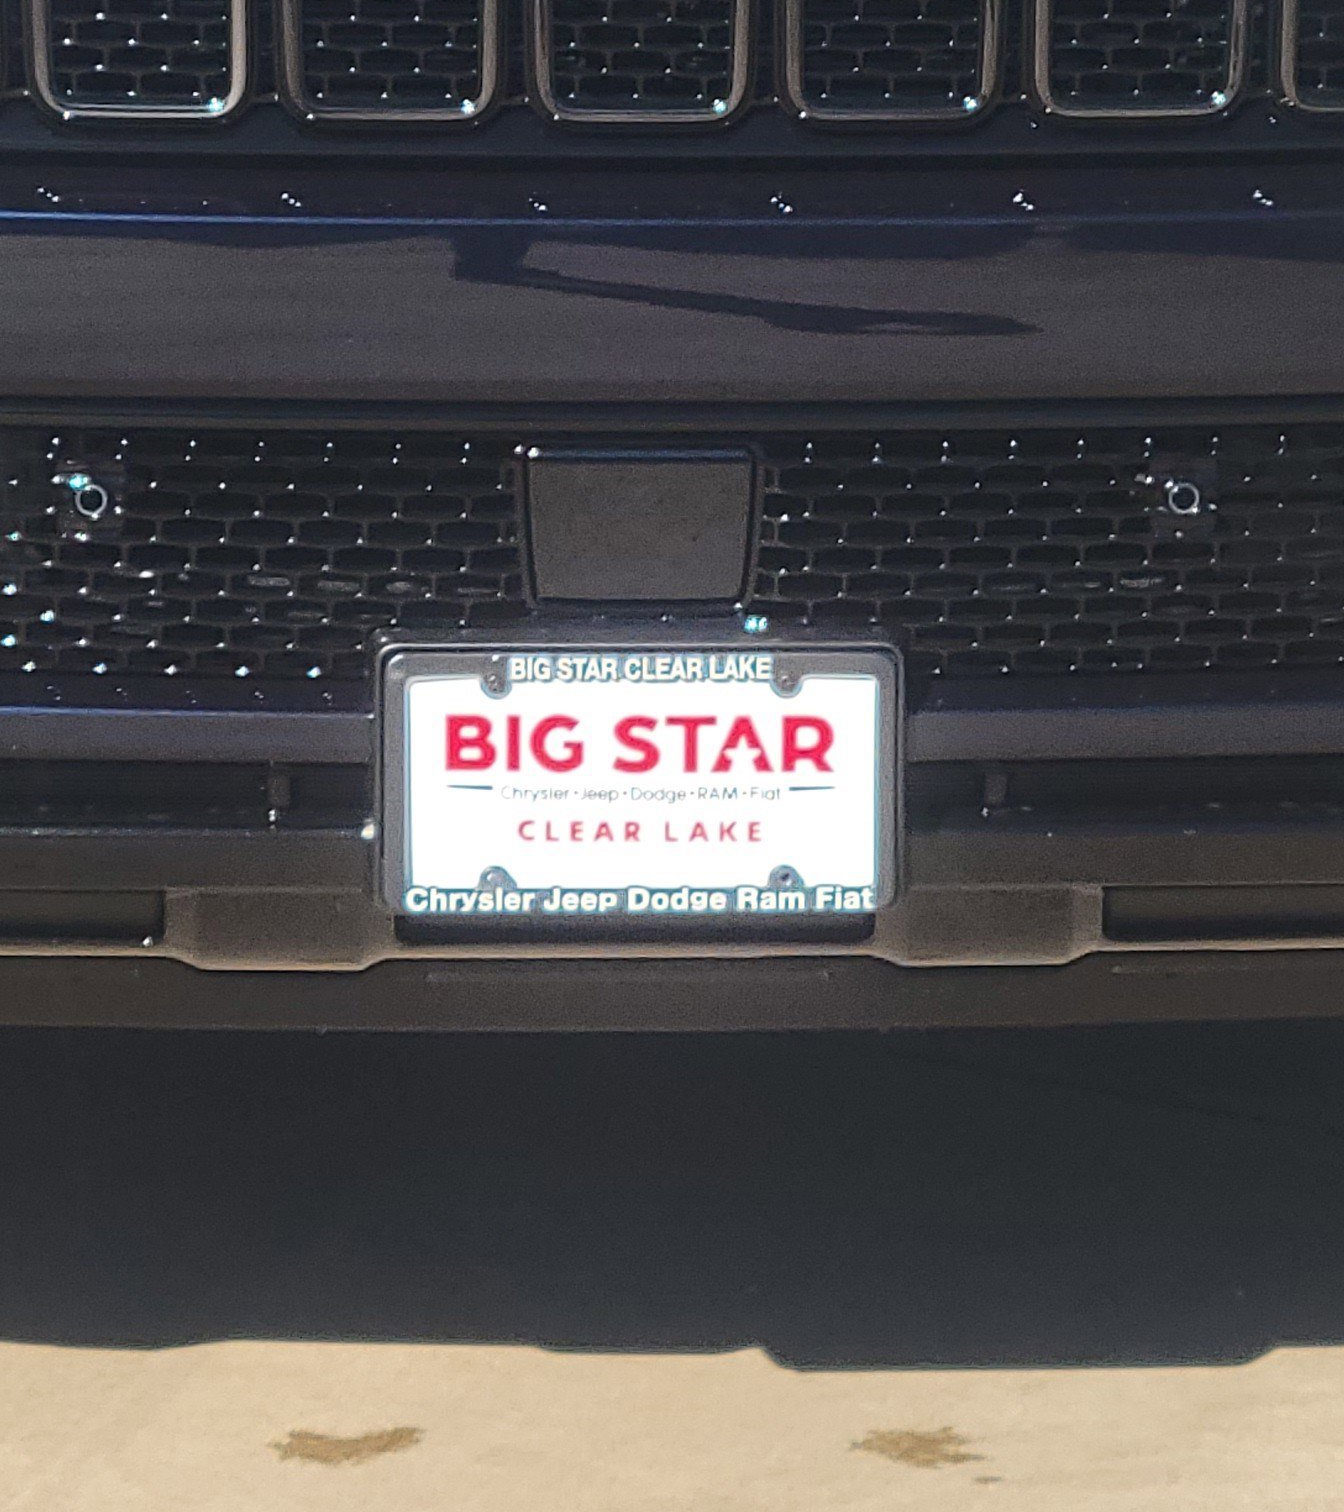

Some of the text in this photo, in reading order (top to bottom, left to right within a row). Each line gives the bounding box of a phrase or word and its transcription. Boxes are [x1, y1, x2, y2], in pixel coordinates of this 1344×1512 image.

[511, 656, 772, 681] BIG STAR CLEAR LAKE
[445, 714, 835, 773] BIG STAR
[500, 785, 782, 803] Chrysler Jeep Dodge RAM Fiat
[518, 820, 762, 842] CLEAR LAKE
[405, 887, 875, 912] Chrysler Jeep Dodge Ram Fiat
